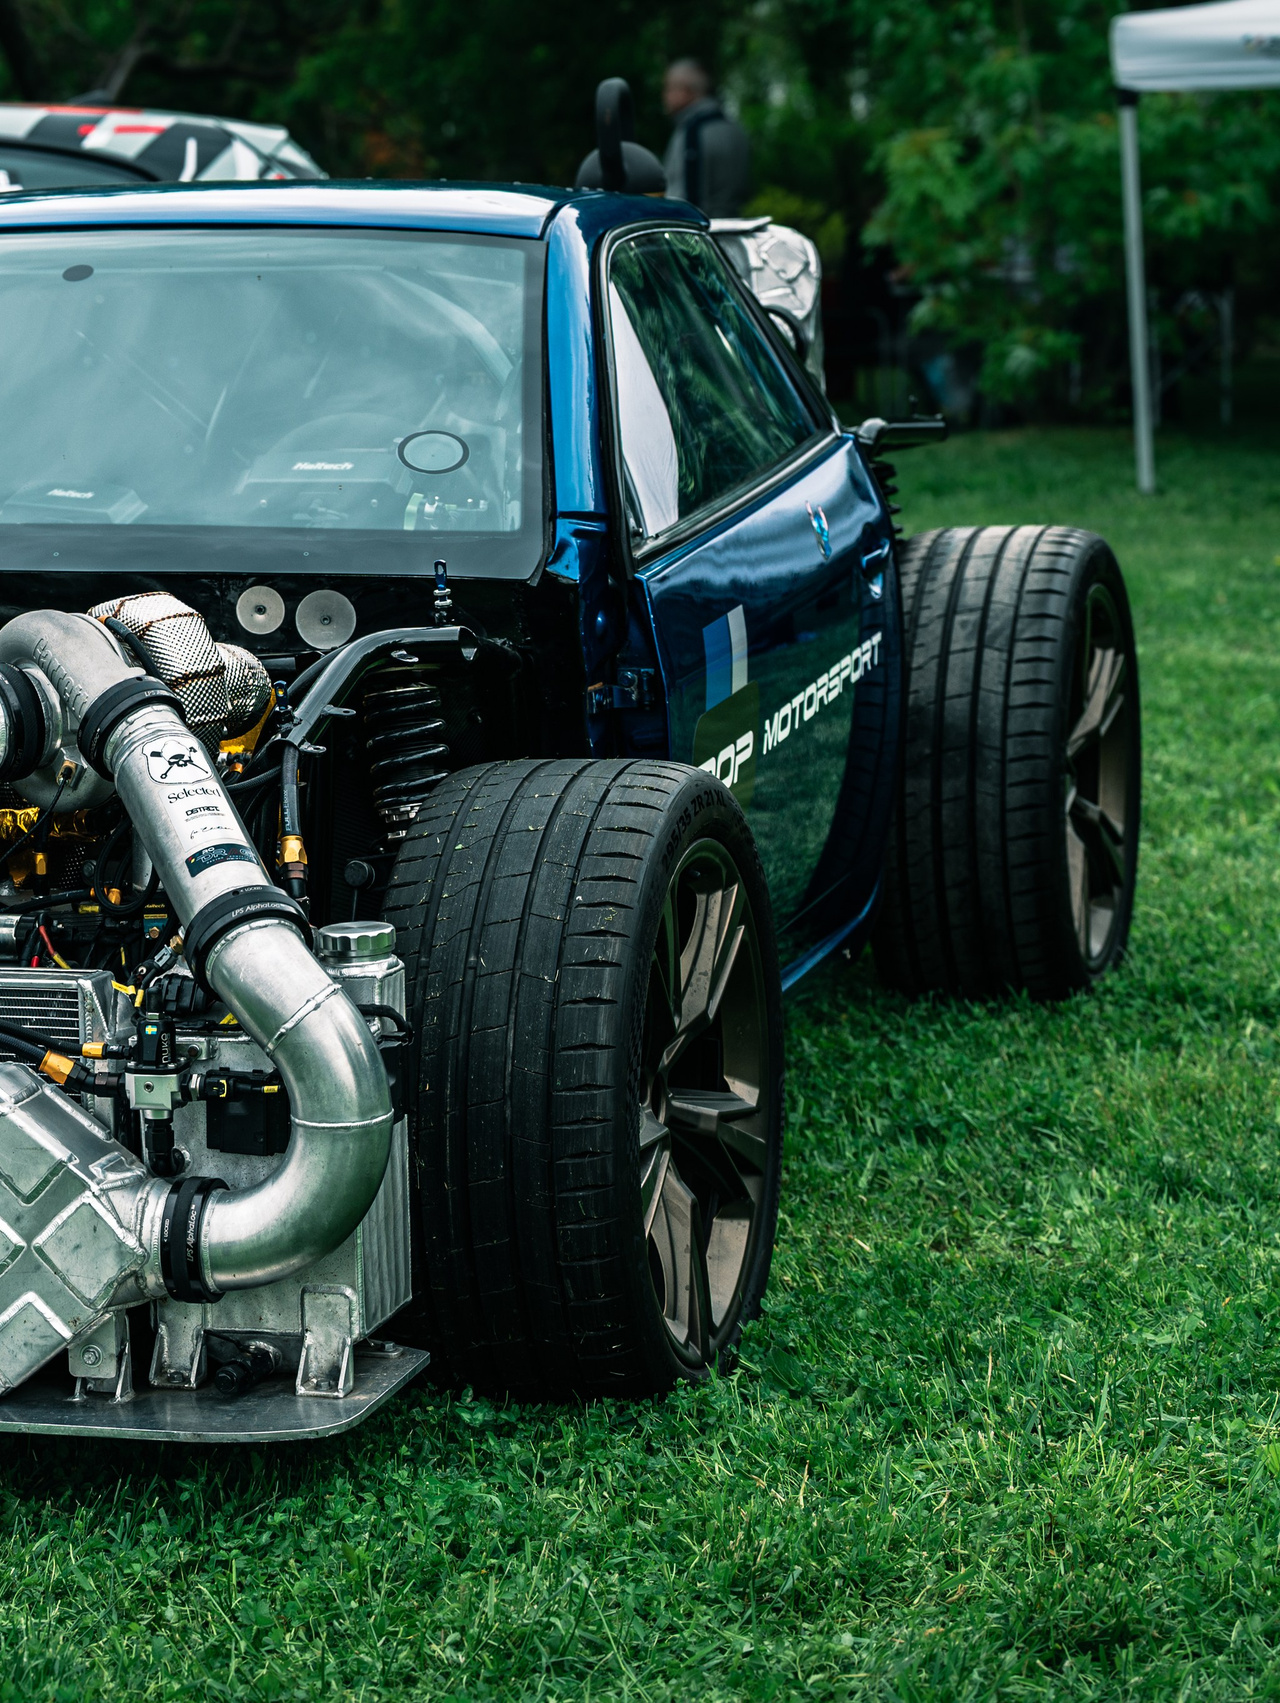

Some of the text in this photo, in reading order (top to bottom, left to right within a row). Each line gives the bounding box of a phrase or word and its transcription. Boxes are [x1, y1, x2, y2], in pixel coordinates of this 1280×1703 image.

[291, 461, 354, 471] Haltech
[762, 631, 883, 756] MOTORSPORT
[167, 787, 222, 804] Selected
[231, 907, 244, 918] LPS
[160, 1032, 171, 1064] nuke
